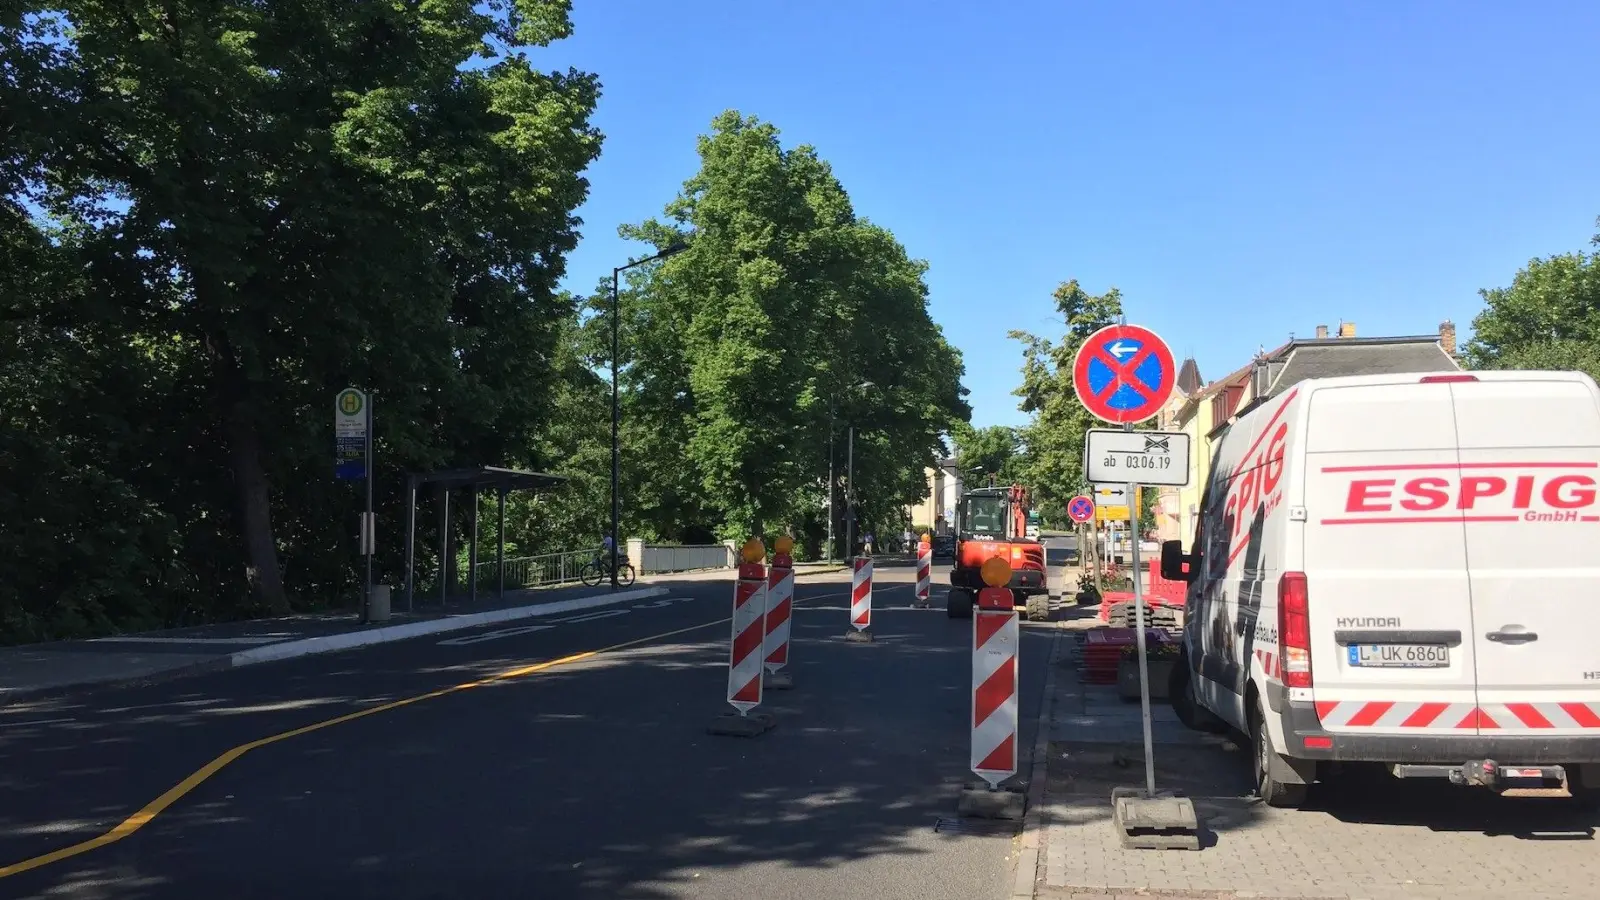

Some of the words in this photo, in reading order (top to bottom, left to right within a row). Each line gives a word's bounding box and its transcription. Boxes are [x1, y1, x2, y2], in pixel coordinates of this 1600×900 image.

[345, 395, 356, 410] H
[1103, 455, 1116, 467] ab
[1126, 455, 1171, 469] 03.06.19
[1345, 475, 1597, 512] ESPIG
[1523, 510, 1578, 522] GmbH
[1336, 617, 1401, 627] HYUNDAI
[1360, 646, 1371, 660] L
[1381, 646, 1402, 660] UK
[1406, 646, 1446, 661] 6860
